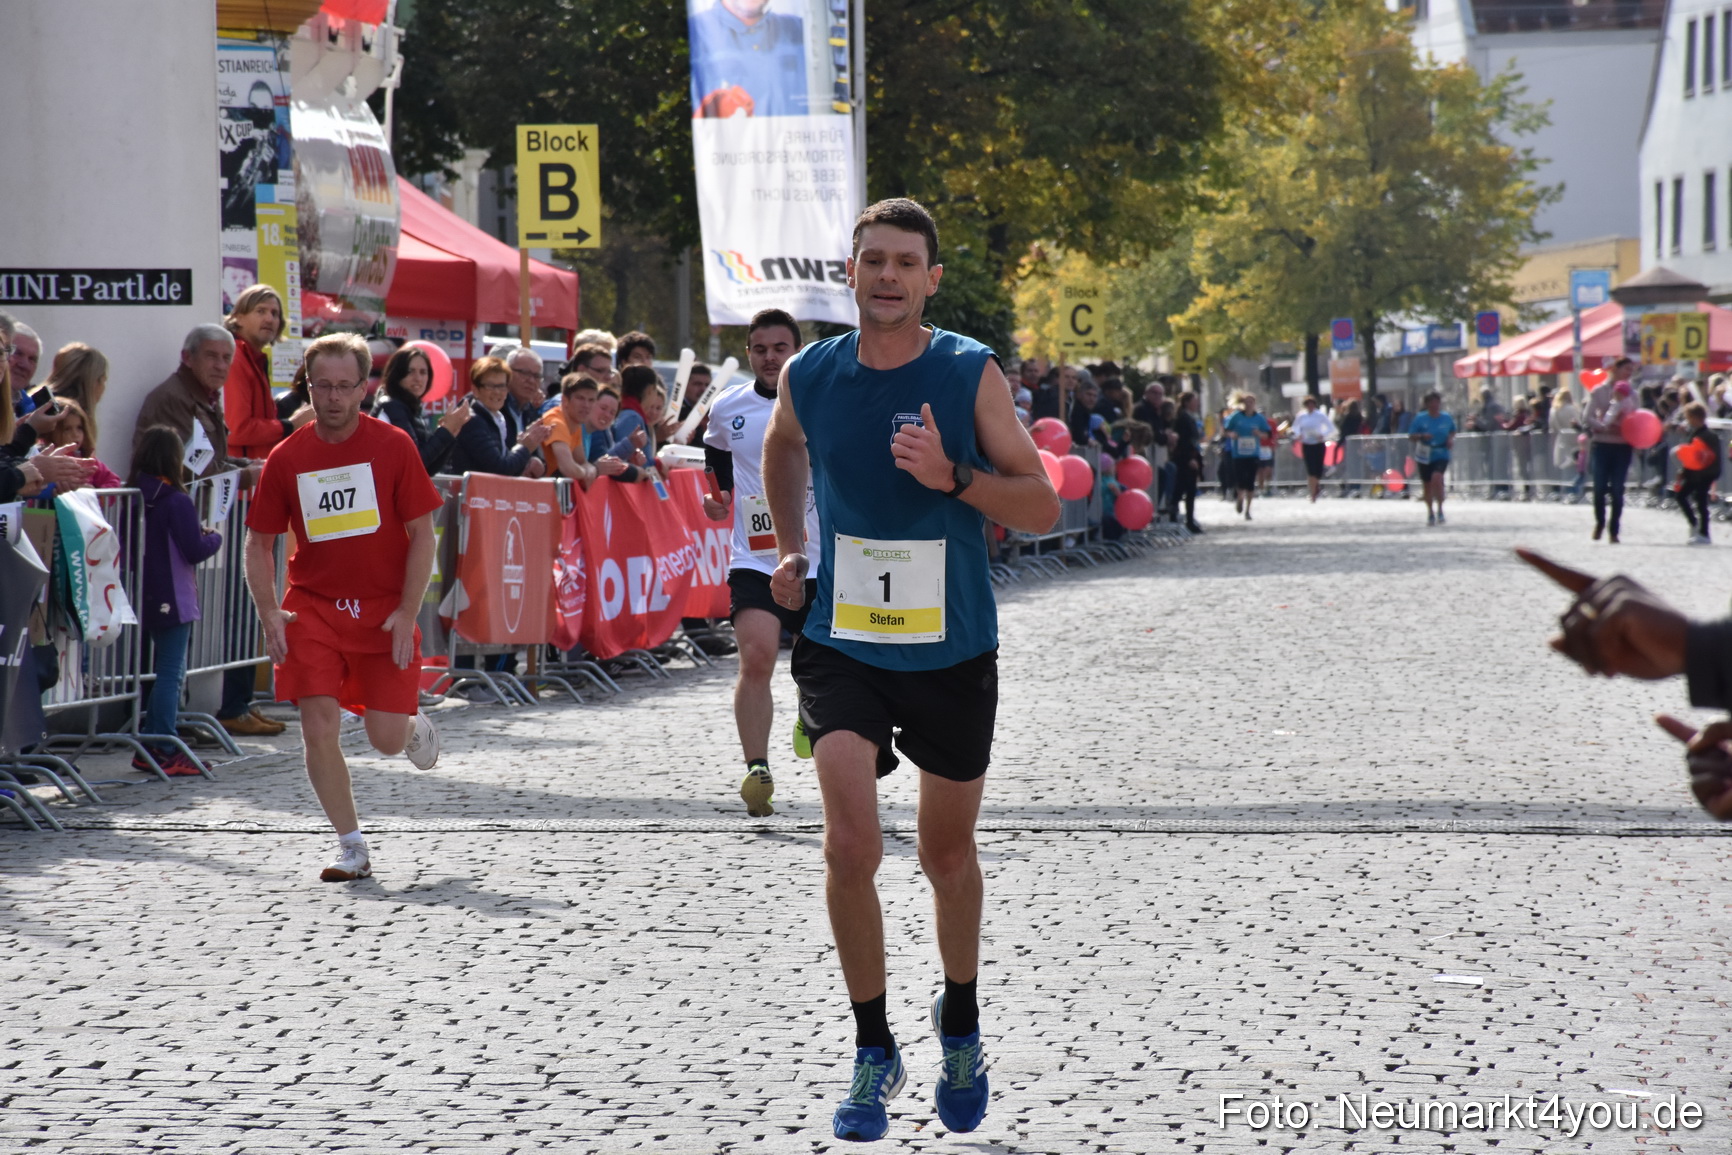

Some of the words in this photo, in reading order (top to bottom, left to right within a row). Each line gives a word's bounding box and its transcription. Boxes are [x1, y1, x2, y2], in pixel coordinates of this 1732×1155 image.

[236, 123, 252, 137] CUP
[527, 130, 589, 152] Block
[539, 163, 579, 221] B
[261, 223, 284, 246] 18.
[1064, 286, 1099, 299] Block
[1070, 303, 1093, 336] C
[1684, 326, 1702, 350] D
[1182, 339, 1198, 362] D
[223, 478, 231, 505] swn
[319, 487, 356, 512] 407
[872, 549, 911, 559] BOCK
[878, 572, 891, 603] 1
[869, 612, 905, 626] Stefan
